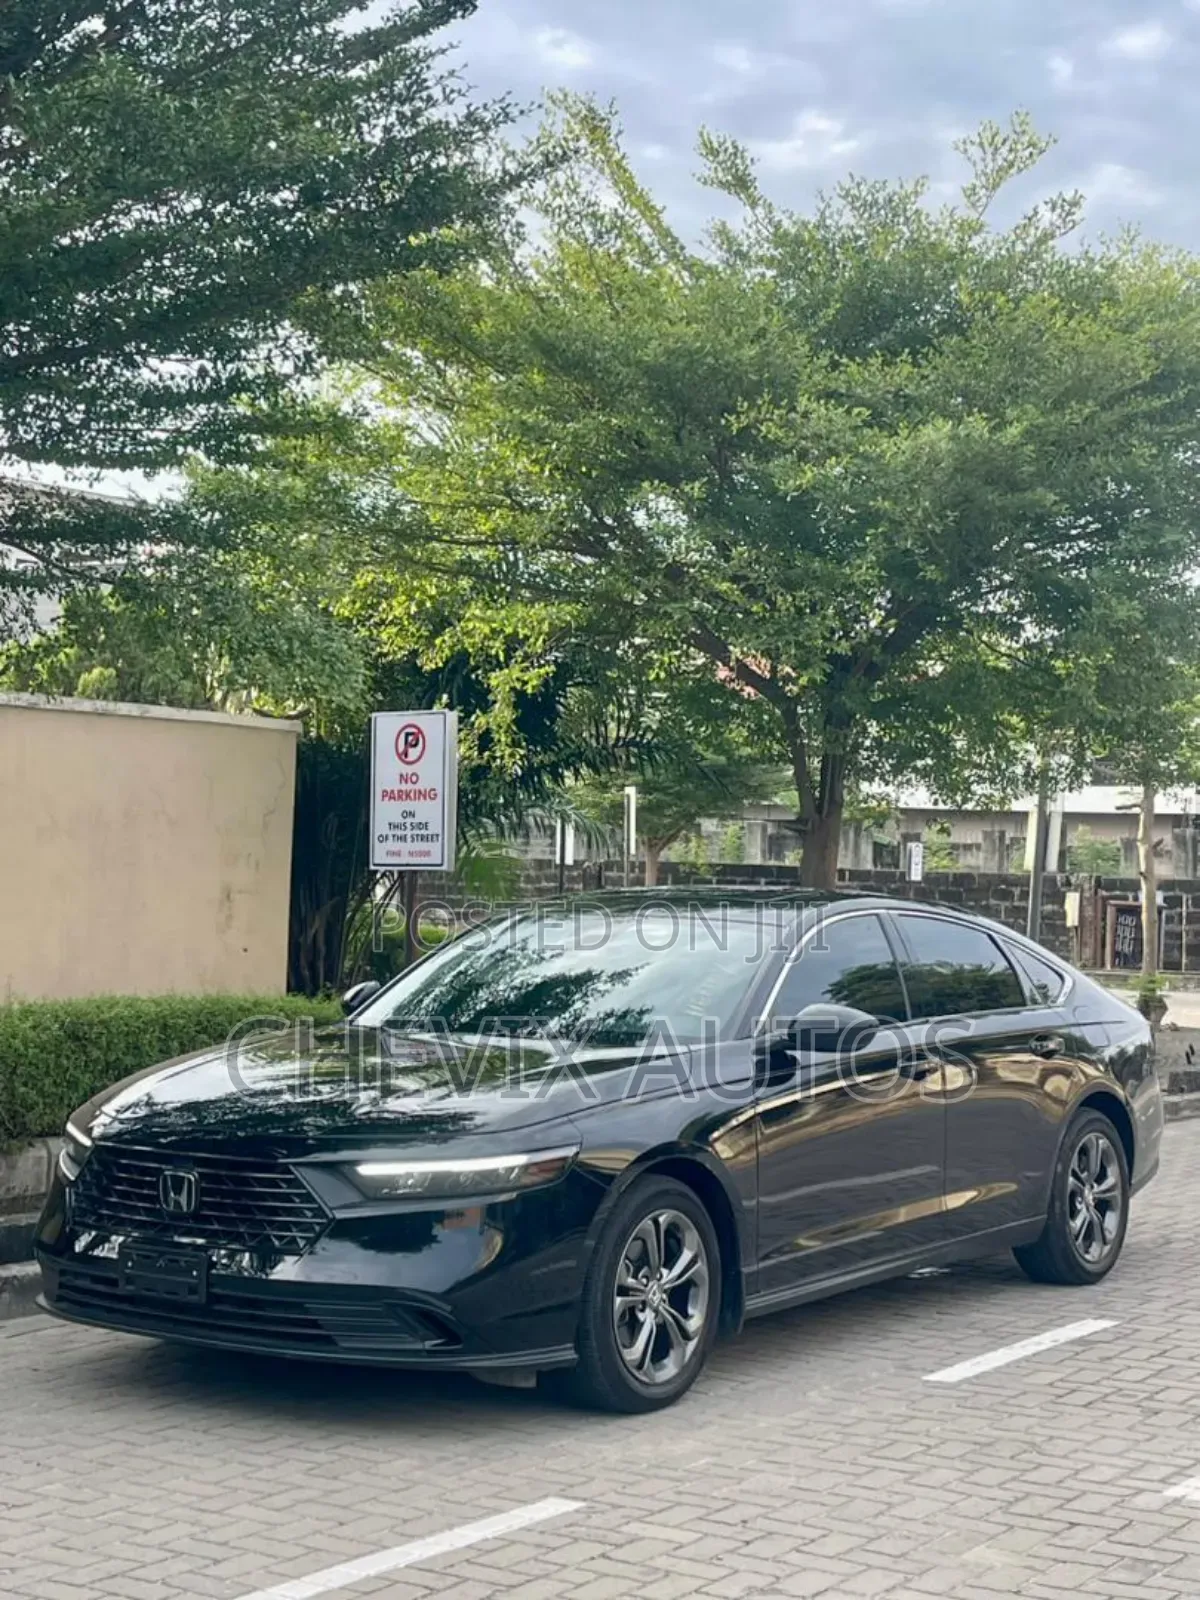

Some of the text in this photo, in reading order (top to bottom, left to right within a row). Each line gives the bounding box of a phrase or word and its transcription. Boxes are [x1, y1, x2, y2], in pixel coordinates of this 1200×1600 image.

[399, 772, 420, 785] NO
[381, 788, 438, 802] PARKING
[401, 809, 416, 819] ON
[387, 821, 429, 831] THIS SIDE
[377, 833, 440, 843] OF THE STREET
